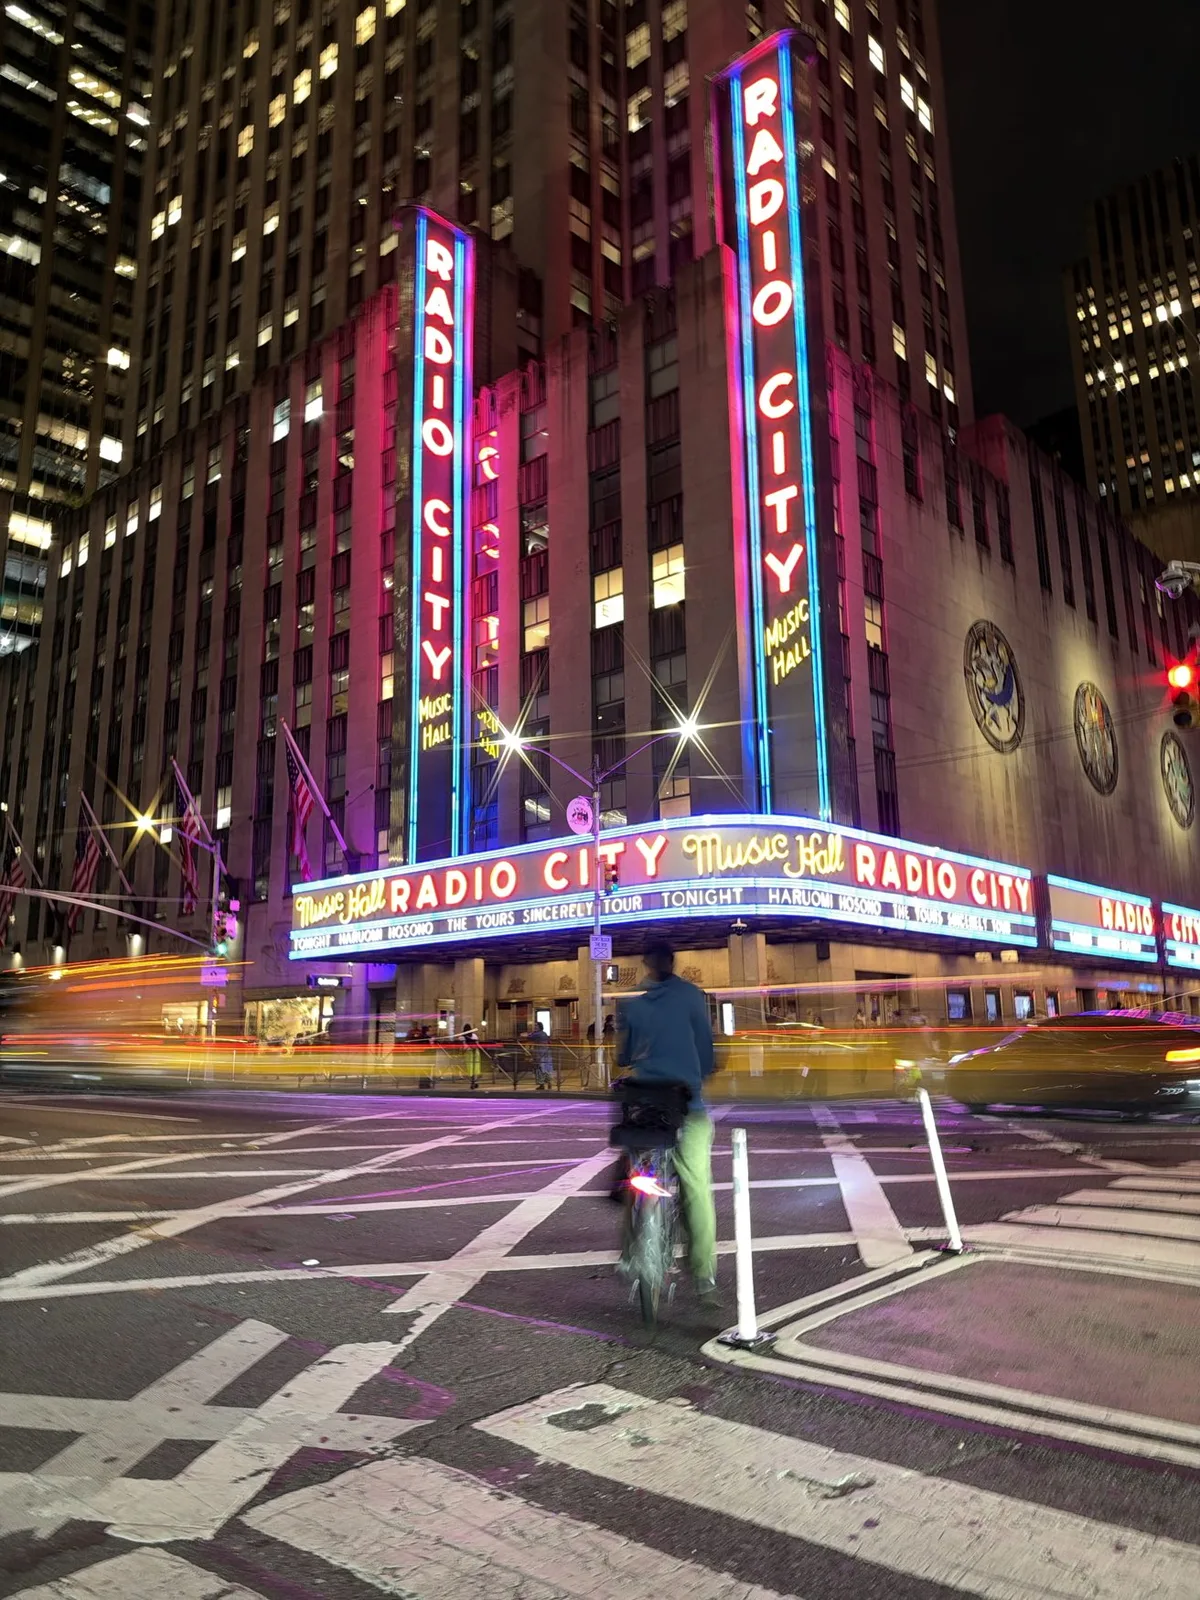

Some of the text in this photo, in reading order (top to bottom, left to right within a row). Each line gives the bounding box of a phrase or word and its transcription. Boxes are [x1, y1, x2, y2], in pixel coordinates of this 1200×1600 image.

[743, 77, 804, 593] RADIO CITY
[421, 239, 454, 681] RADIO CITY
[763, 598, 810, 656] MUSIC
[772, 636, 811, 686] HALL
[419, 693, 452, 724] MUSIC
[423, 725, 452, 751] HALL
[682, 831, 845, 878] Music Hall
[855, 843, 1030, 913] RADIO CITY
[295, 834, 668, 929] Music Hall RADIO CITY
[447, 917, 467, 932] THE
[476, 911, 515, 928] YOURS
[522, 902, 594, 924] SINCERELY
[603, 895, 643, 914] TOUR
[661, 888, 743, 906] TONIGHT
[768, 888, 834, 909] HARUOMI
[1101, 897, 1154, 936] RADIO
